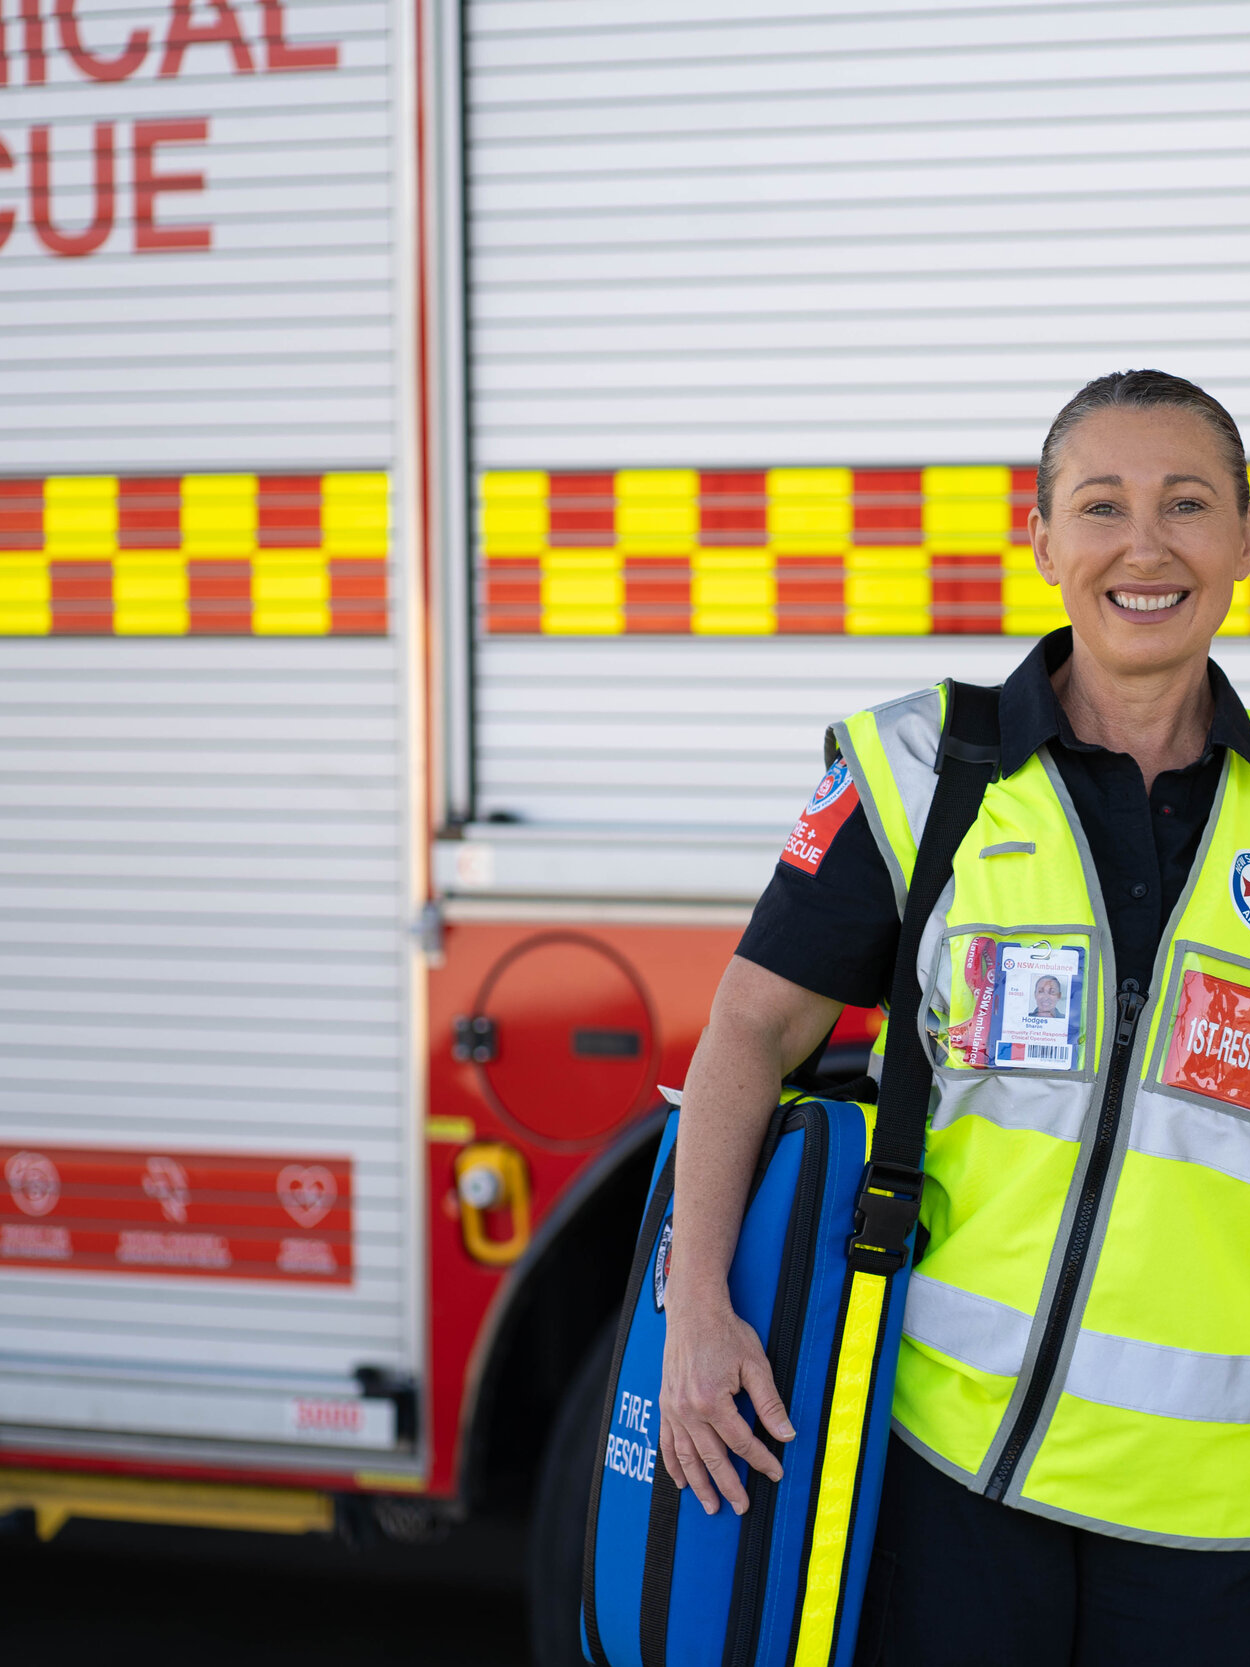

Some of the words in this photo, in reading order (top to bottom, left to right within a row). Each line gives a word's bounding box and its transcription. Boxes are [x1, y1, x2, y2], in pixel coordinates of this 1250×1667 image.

[0, 0, 341, 88] ICAL
[785, 836, 823, 865] ESCUE
[1235, 855, 1247, 875] NEW
[1021, 1016, 1049, 1025] Hodges
[1186, 1017, 1220, 1058] 1ST
[618, 1391, 653, 1434] FIRE
[604, 1433, 657, 1485] RESCUE
